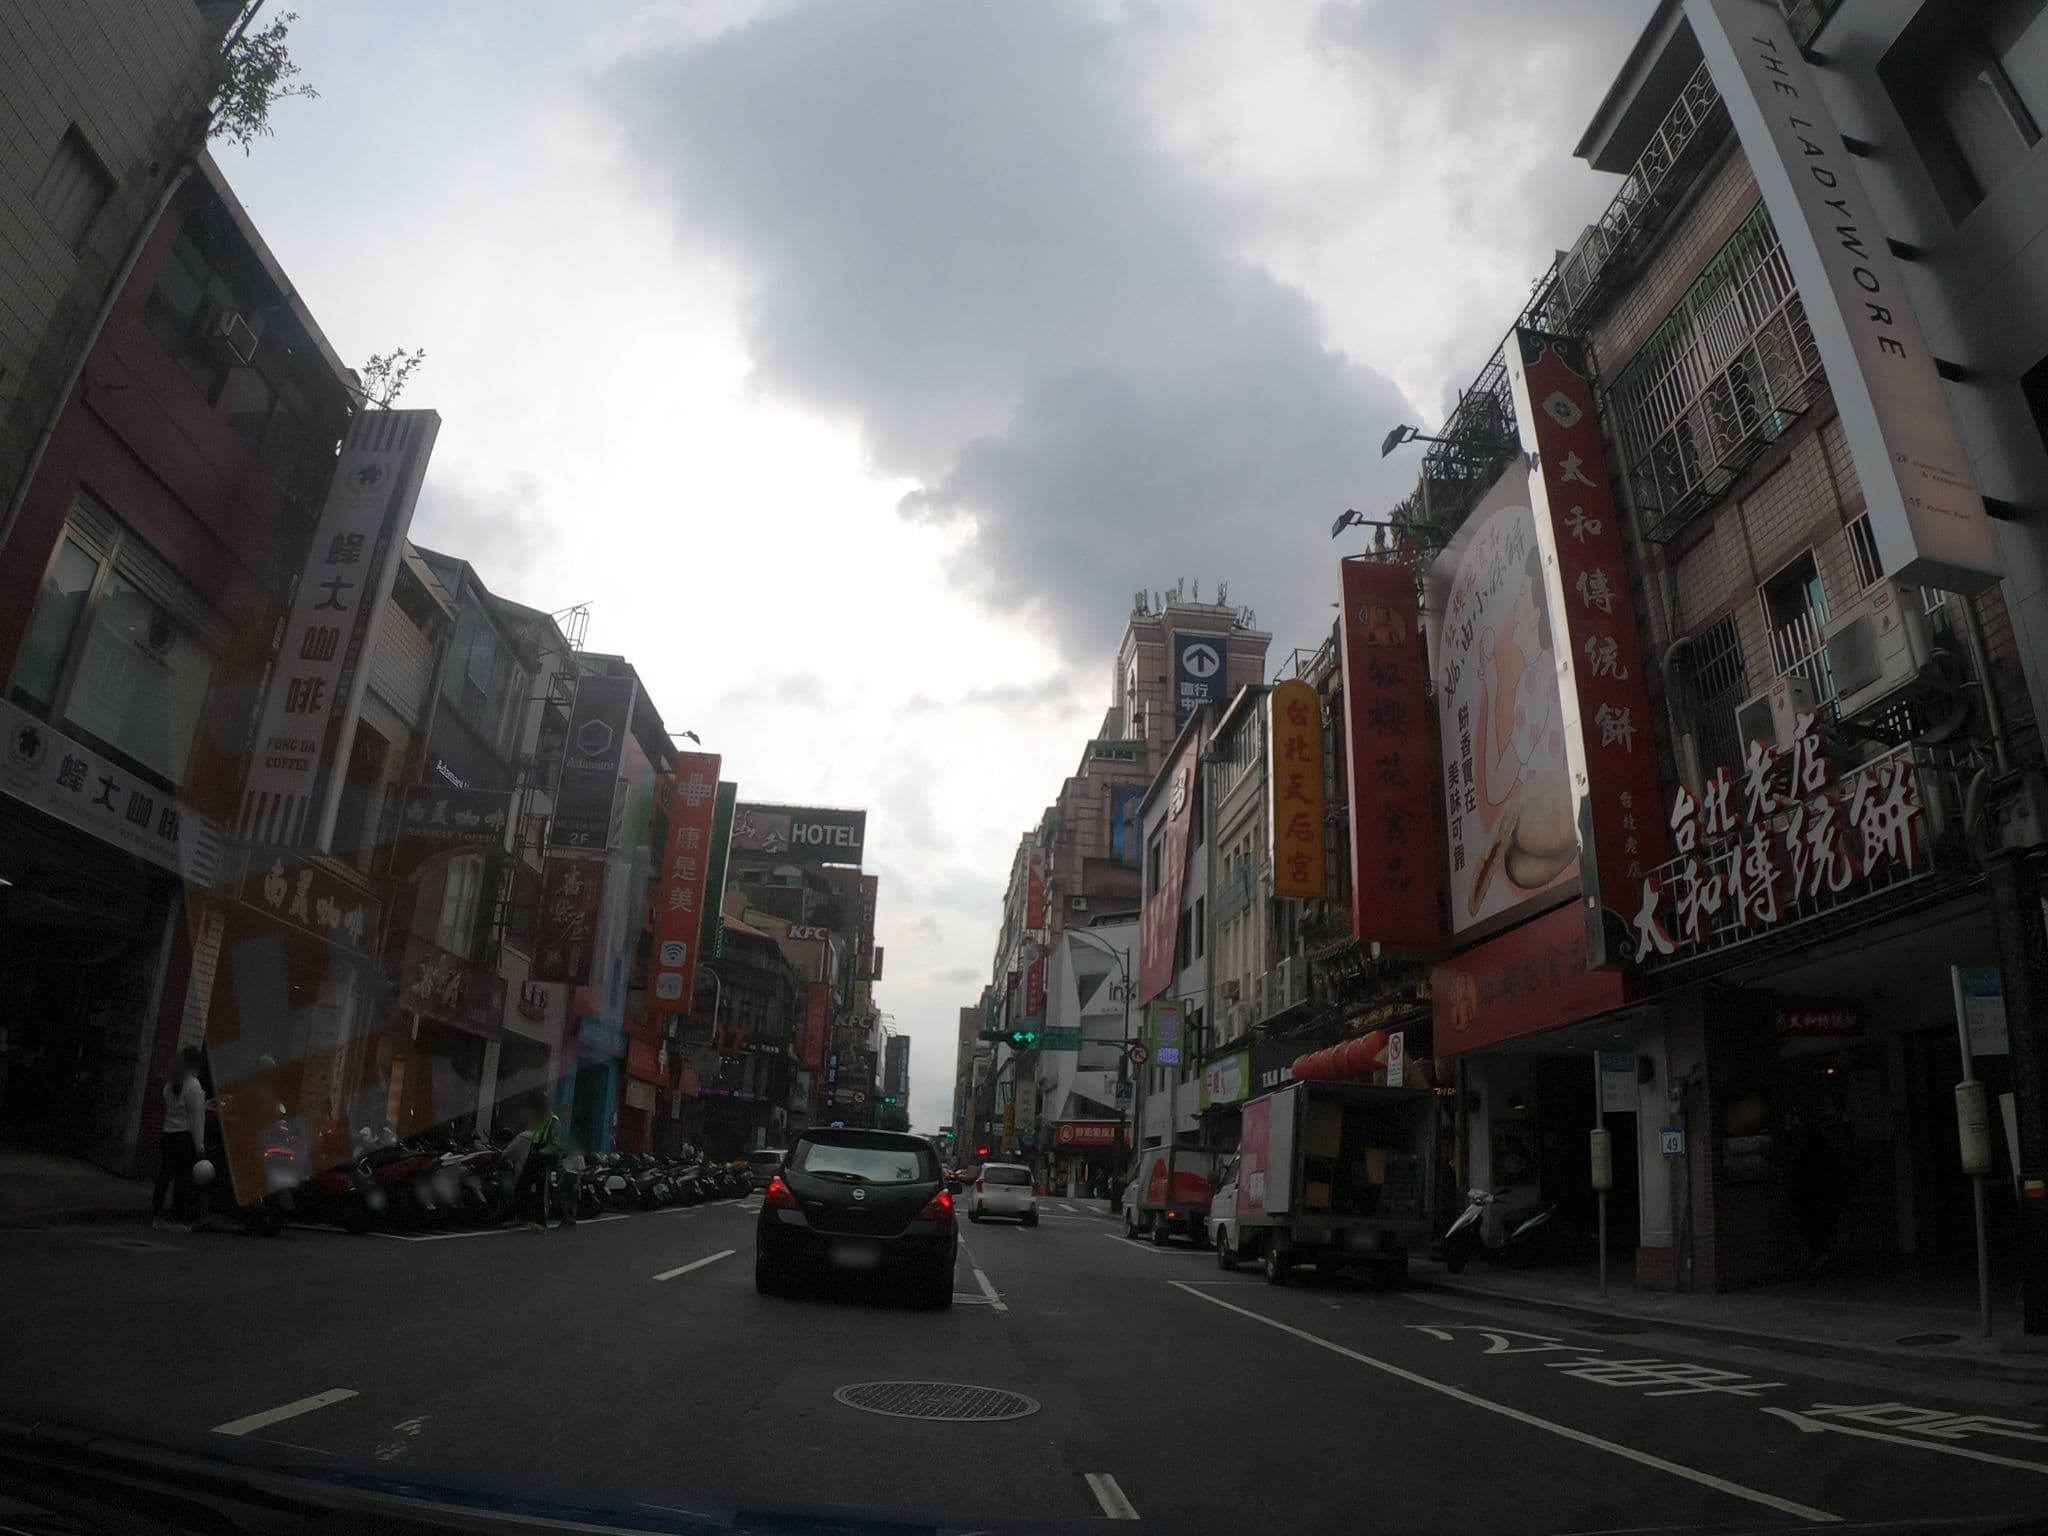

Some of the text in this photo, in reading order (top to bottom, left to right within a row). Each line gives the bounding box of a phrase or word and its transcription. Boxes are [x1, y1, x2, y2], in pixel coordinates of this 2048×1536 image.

[1752, 36, 1907, 360] THE LADYWORE
[284, 532, 365, 715] 蜂大咖啡
[266, 755, 311, 772] COFFEE
[1283, 698, 1314, 883] 台北天后宮
[1671, 713, 1826, 851] 台北老店
[569, 832, 591, 846] 2F
[792, 823, 861, 848] HOTEL
[1447, 761, 1467, 873] 美味可靠
[668, 825, 702, 914] 康是美
[1632, 760, 1920, 964] 太和傳統餅
[788, 924, 827, 940] KFC
[836, 1014, 873, 1029] KFC
[1667, 1137, 1678, 1151] 49
